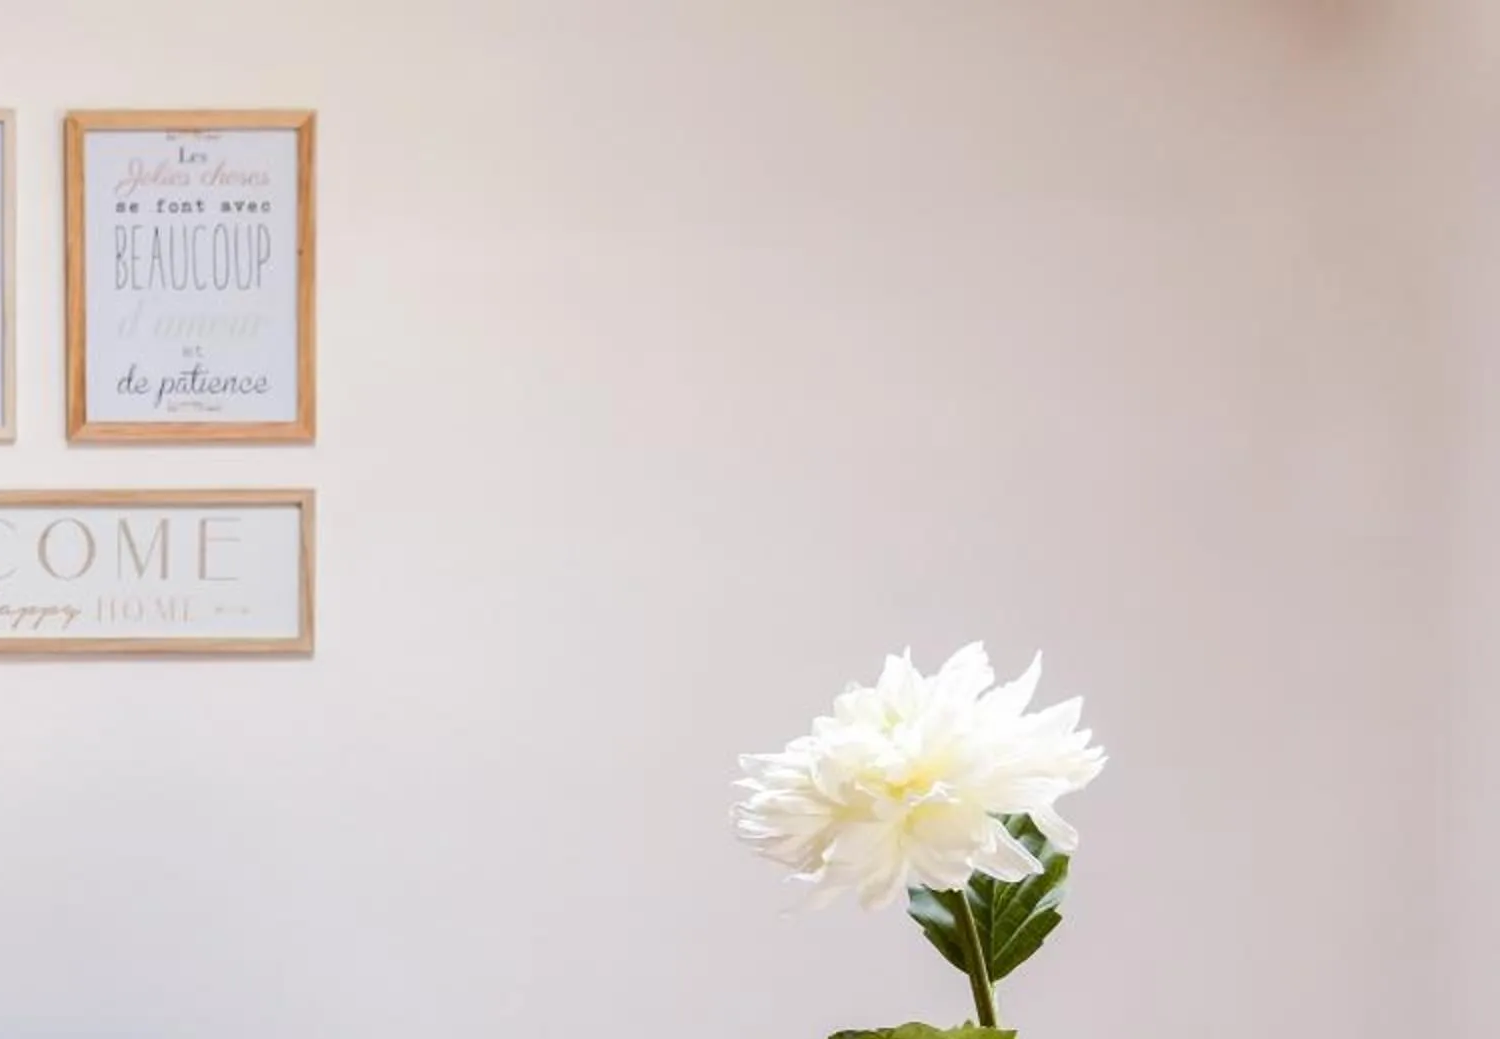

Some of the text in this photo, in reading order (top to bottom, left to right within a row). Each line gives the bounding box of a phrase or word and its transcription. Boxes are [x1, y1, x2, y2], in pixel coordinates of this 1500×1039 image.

[178, 146, 207, 163] Les
[115, 198, 271, 213] se font avec
[114, 223, 271, 291] BEAUCOUP
[117, 362, 271, 409] de patience
[96, 596, 197, 622] HOME
